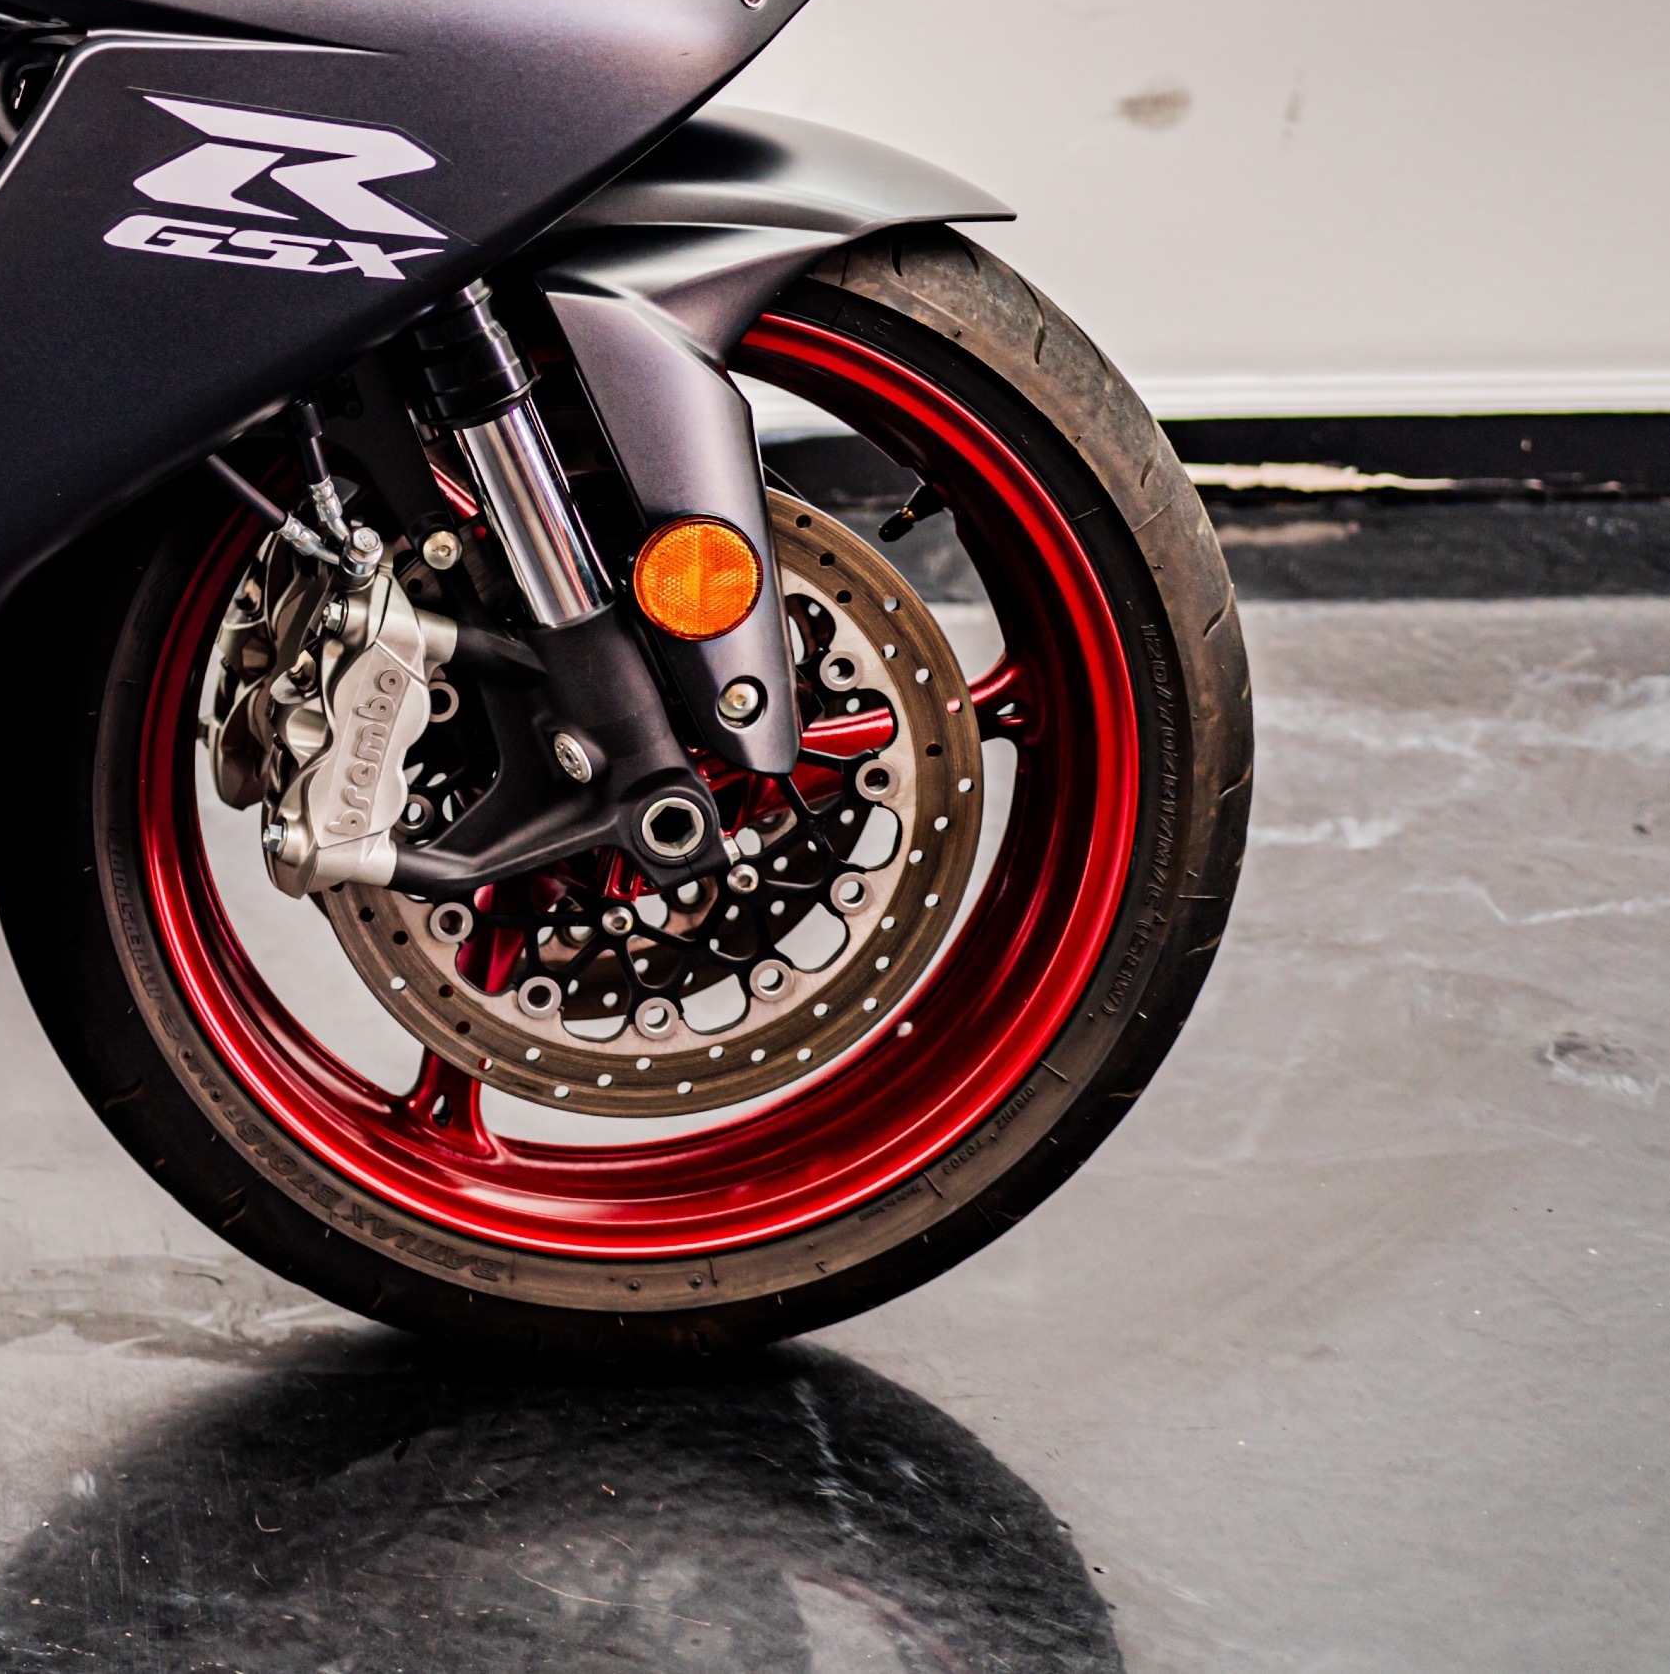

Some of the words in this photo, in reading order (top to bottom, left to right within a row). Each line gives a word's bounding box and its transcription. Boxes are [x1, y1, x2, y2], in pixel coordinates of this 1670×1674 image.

[103, 214, 445, 279] GSX
[327, 666, 405, 837] brembo
[345, 1203, 506, 1282] BATTLAX
